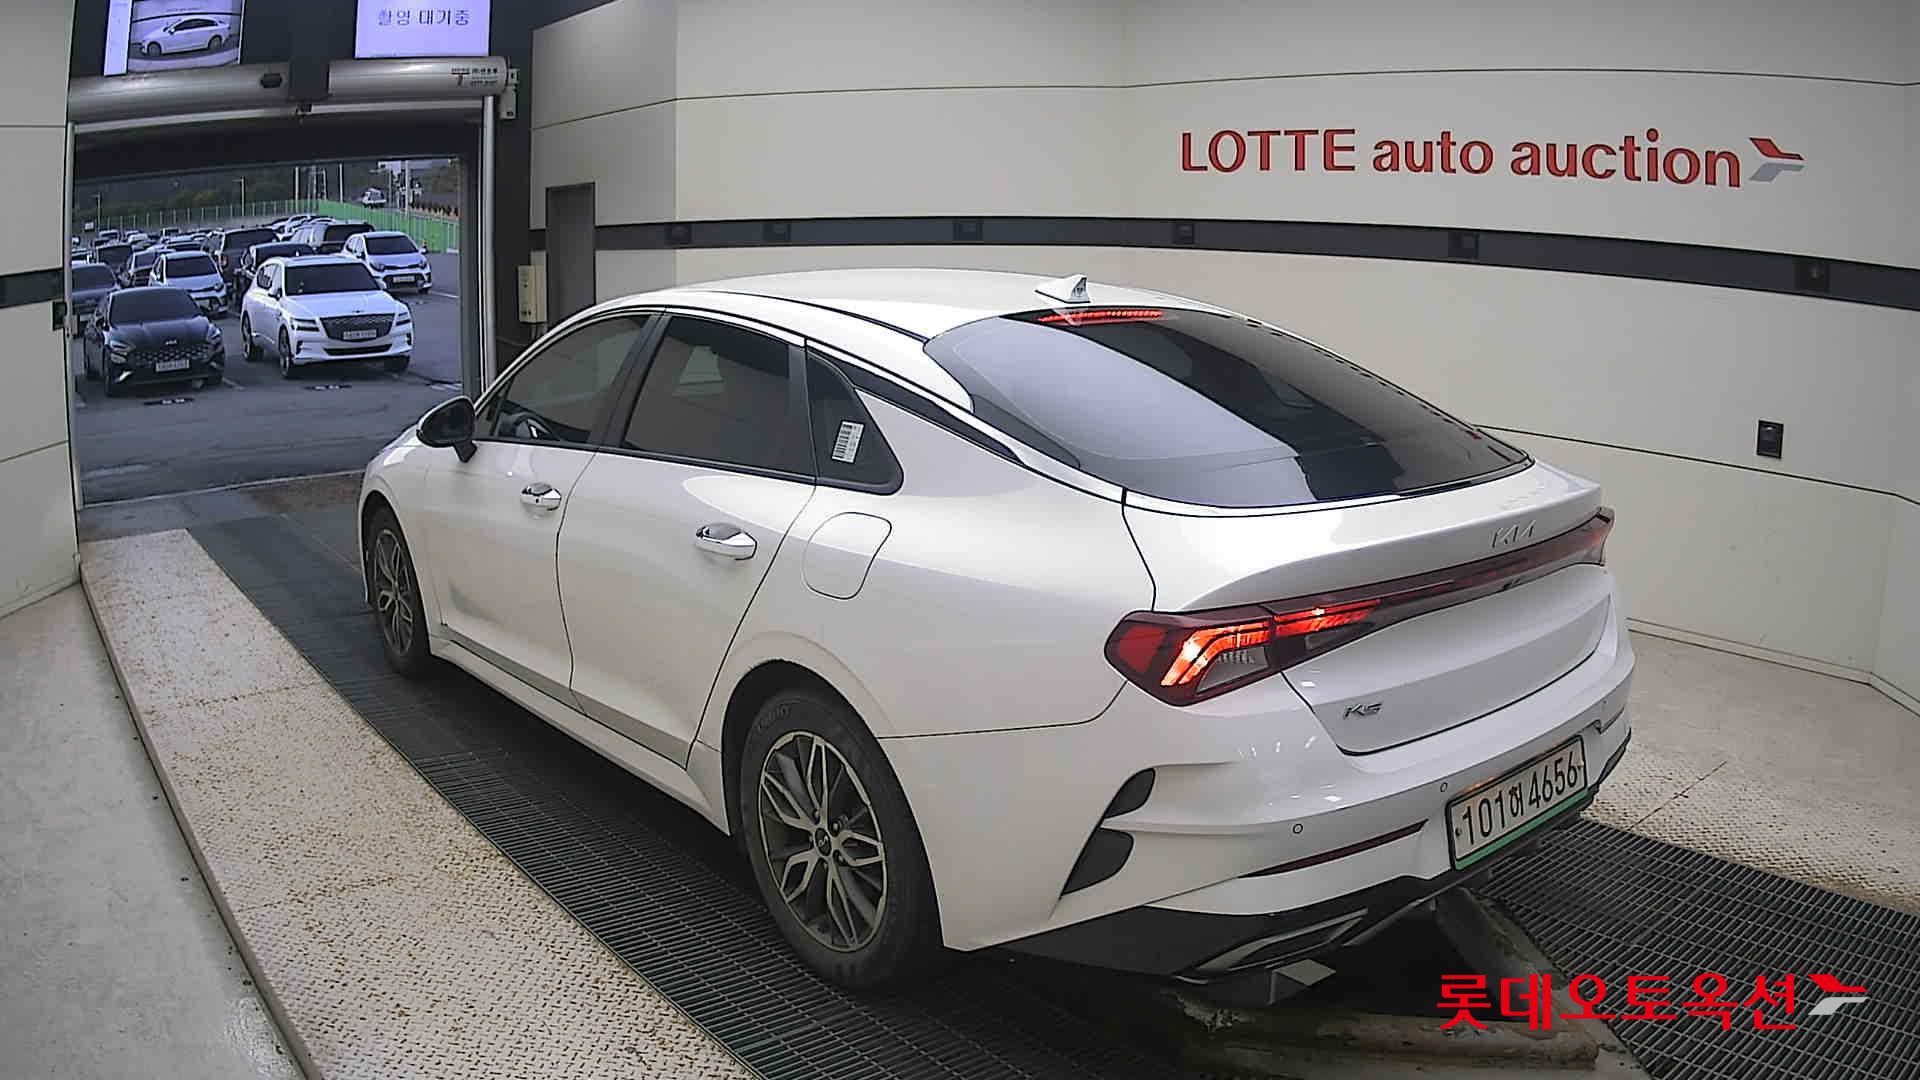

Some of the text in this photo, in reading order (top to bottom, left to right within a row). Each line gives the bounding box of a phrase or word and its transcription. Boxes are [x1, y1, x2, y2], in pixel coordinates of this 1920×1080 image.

[418, 8, 471, 26] 대기중
[1180, 128, 1742, 189] LOTTE auto auction
